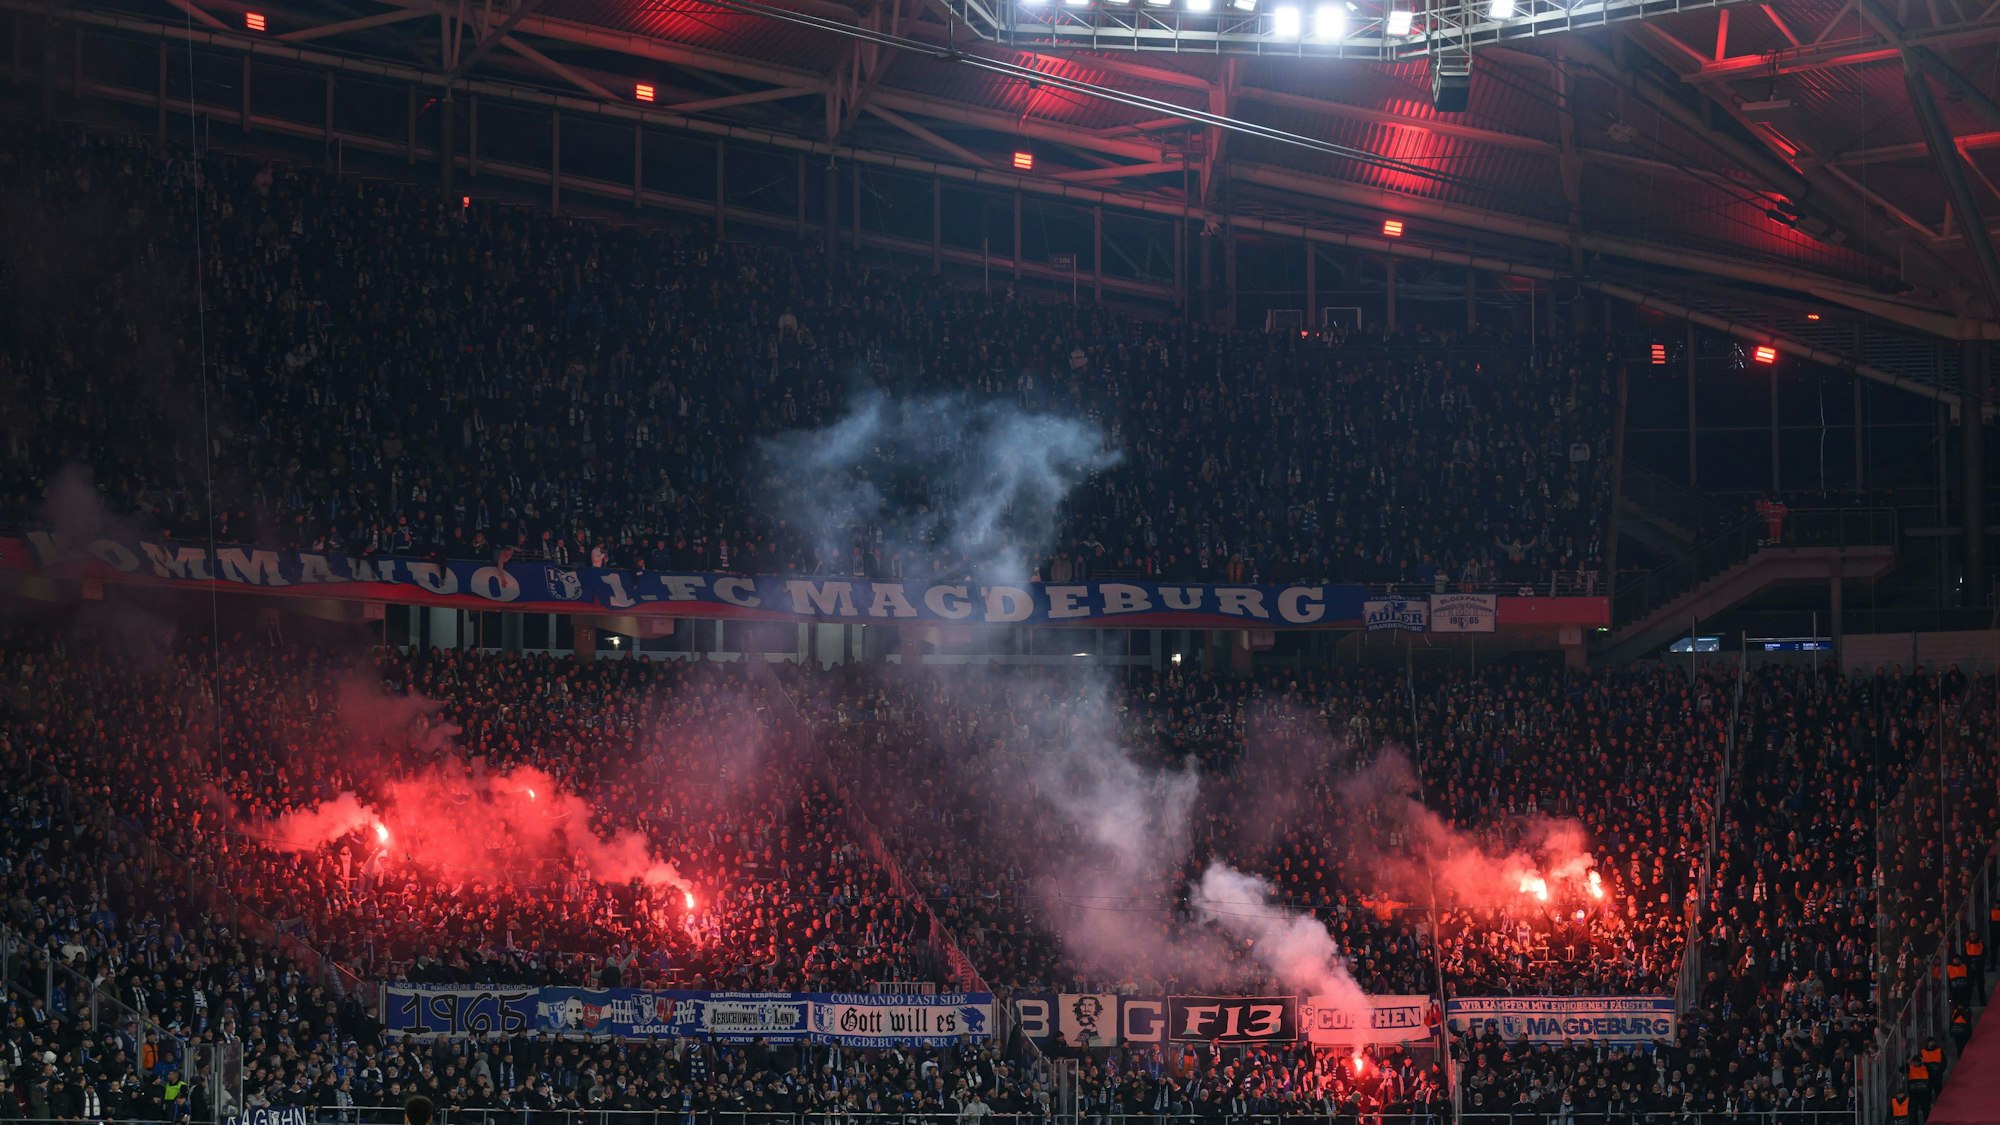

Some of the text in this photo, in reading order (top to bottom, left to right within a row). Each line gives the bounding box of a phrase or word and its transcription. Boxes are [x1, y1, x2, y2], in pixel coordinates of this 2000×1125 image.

[789, 579, 1327, 623] MAGDEBURG
[1368, 602, 1423, 623] ADLER
[831, 993, 968, 1005] COMMANDO EAST SIDE
[1460, 1000, 1654, 1010] WIR KÄMPFEN MIT ERHOBENEN FÄUSTEN
[401, 992, 528, 1035] 1965
[841, 1006, 956, 1033] Gott will es
[1016, 999, 1165, 1042] B G
[632, 1025, 669, 1034] BLOCK
[1527, 1017, 1670, 1035] MAGDEBURG
